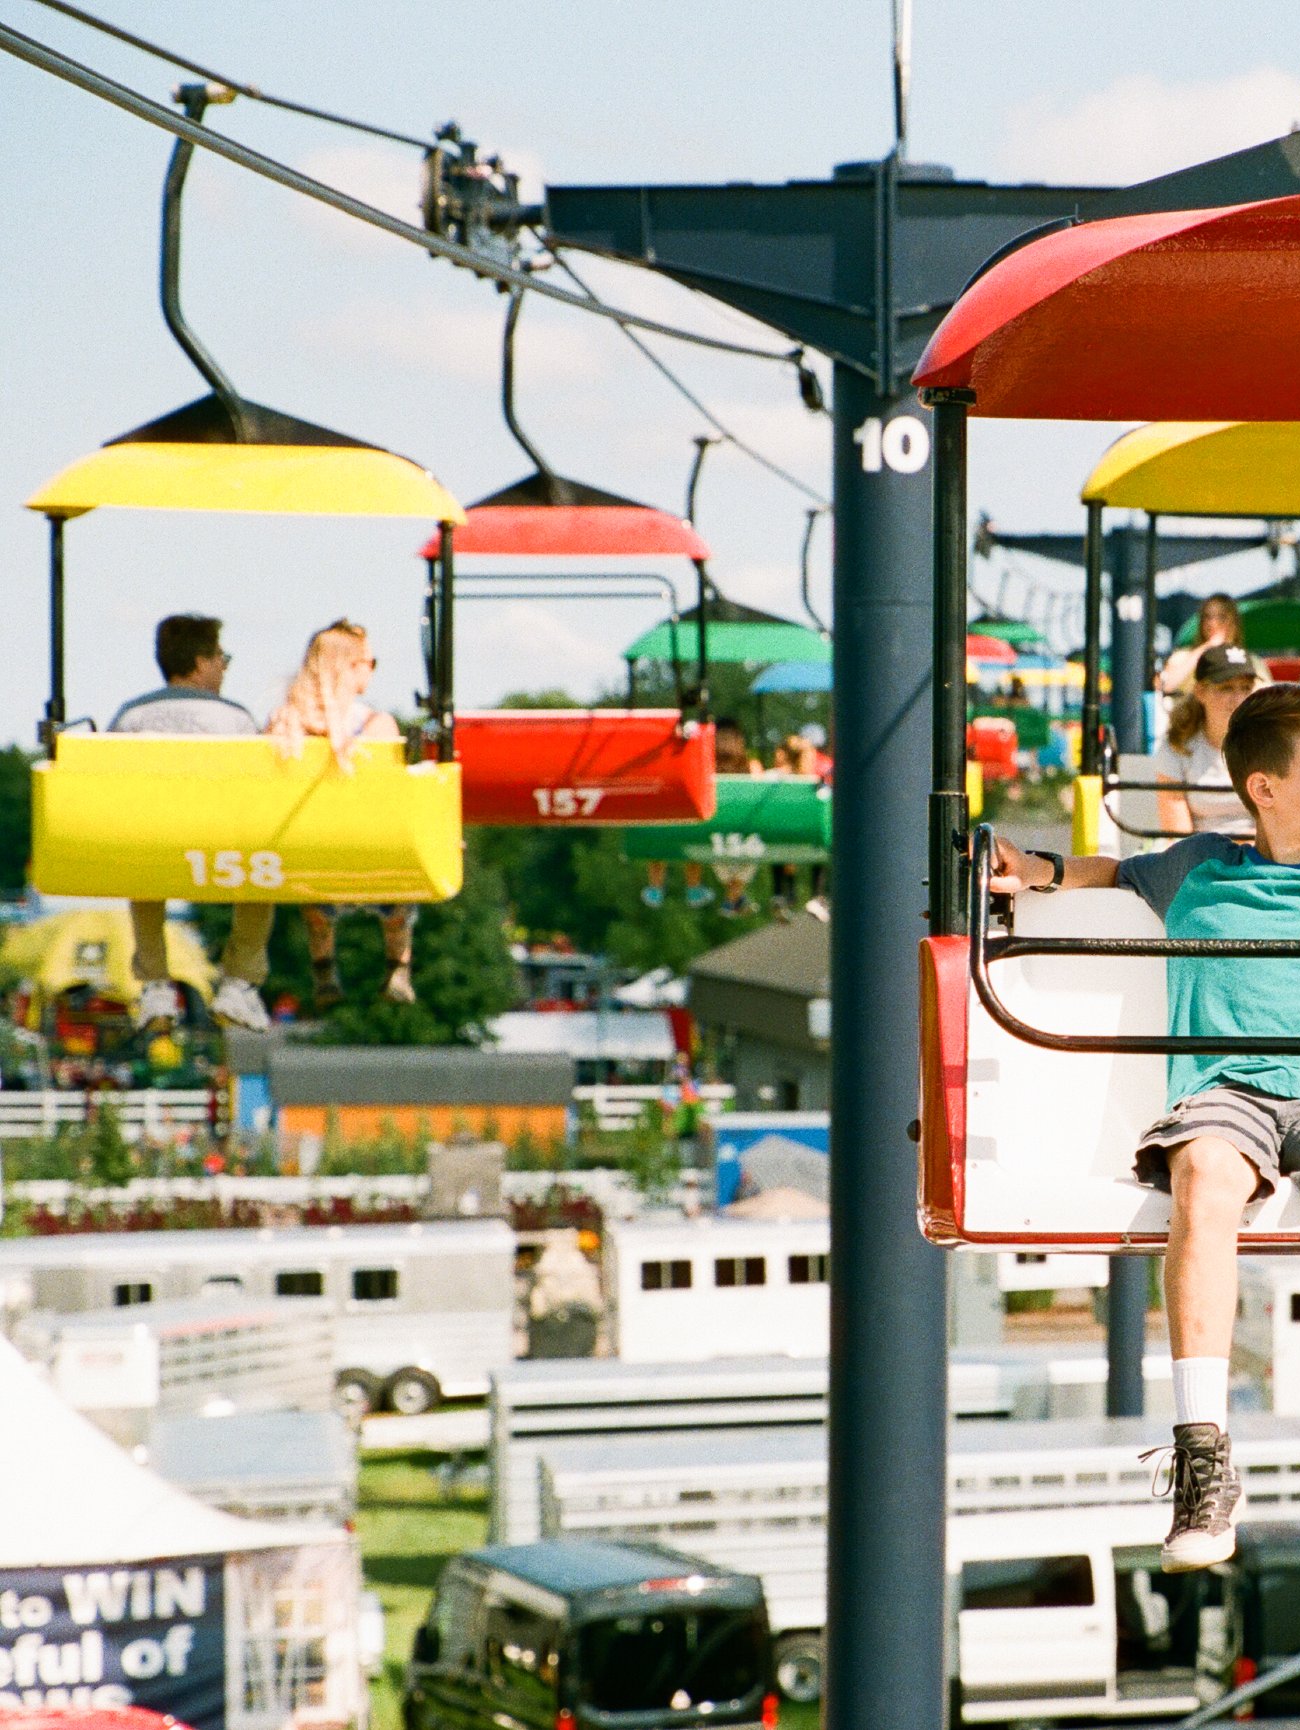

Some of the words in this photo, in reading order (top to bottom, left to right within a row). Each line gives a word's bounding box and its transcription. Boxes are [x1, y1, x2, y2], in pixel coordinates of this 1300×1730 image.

[853, 416, 929, 473] 10
[532, 788, 606, 816] 157
[185, 850, 285, 888] 158
[0, 1589, 52, 1629] to
[62, 1567, 206, 1625] WIN
[121, 1624, 195, 1680] of
